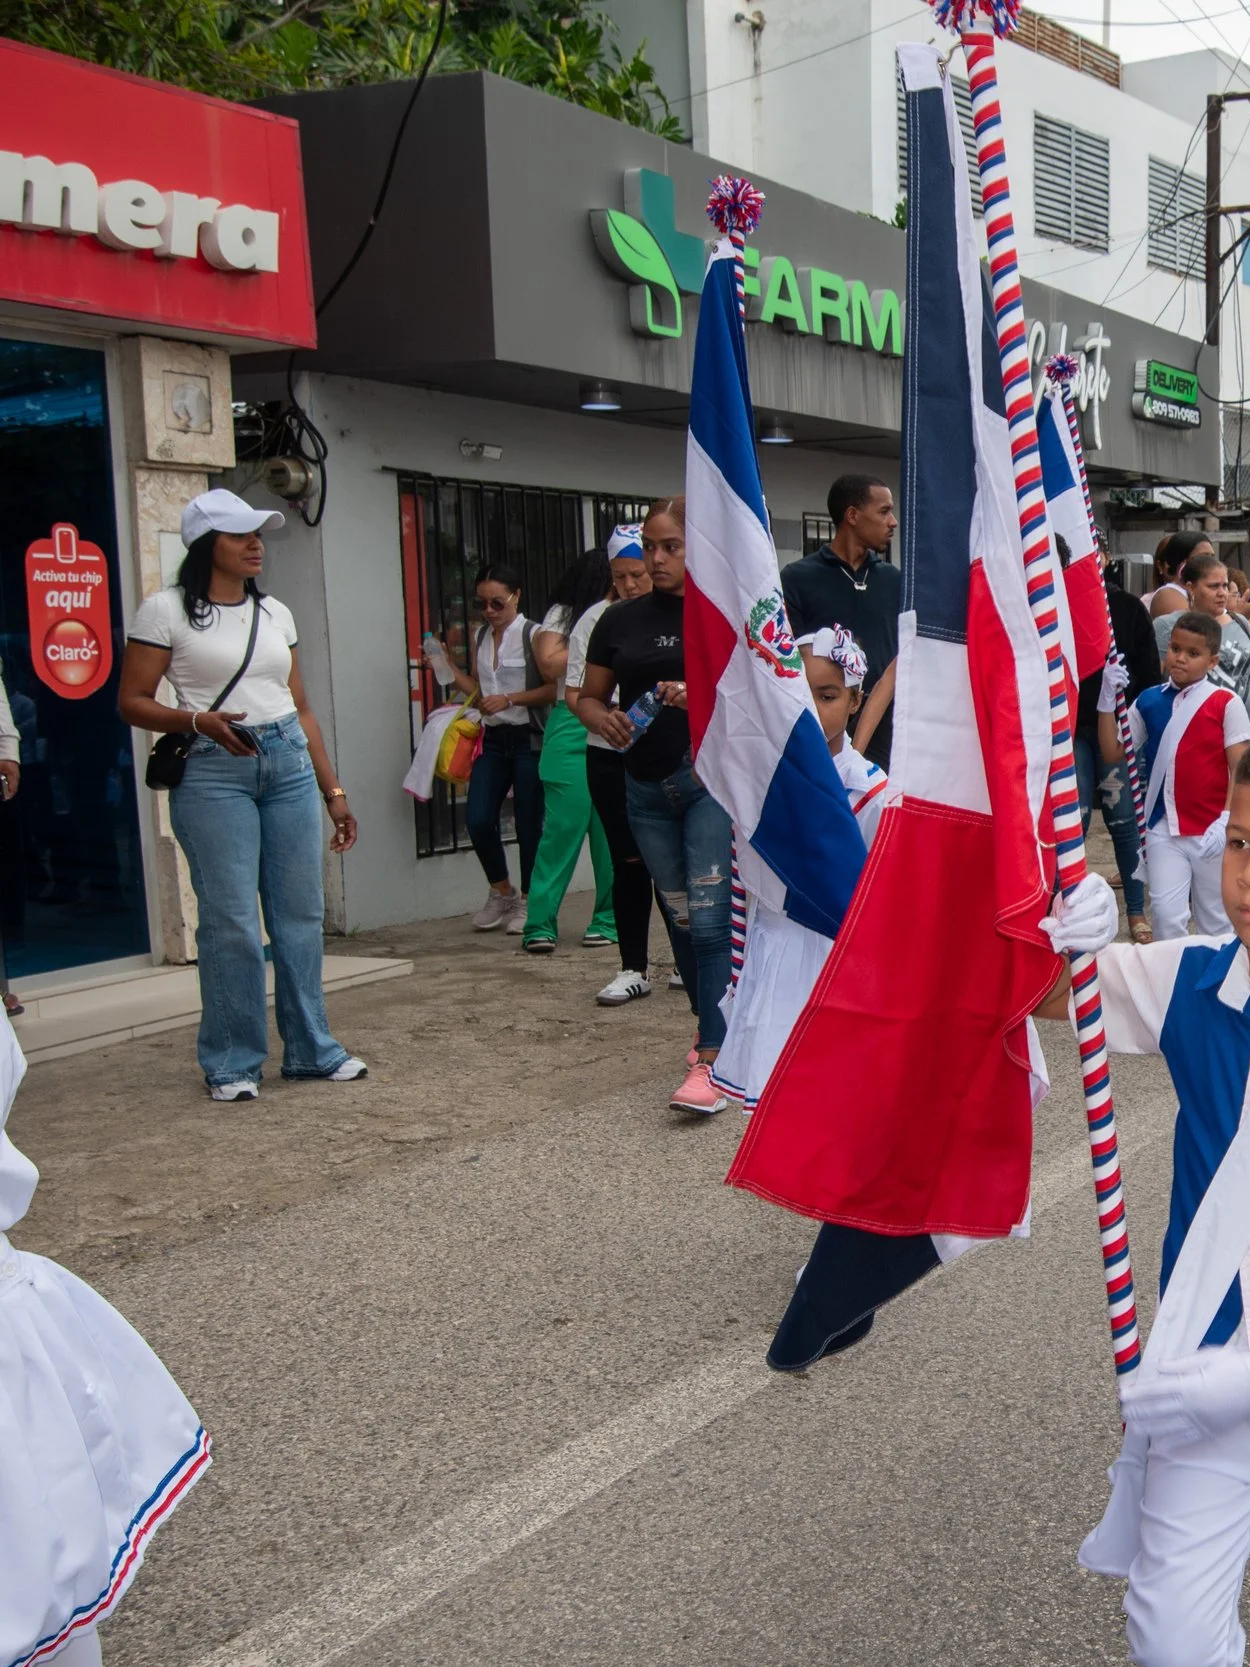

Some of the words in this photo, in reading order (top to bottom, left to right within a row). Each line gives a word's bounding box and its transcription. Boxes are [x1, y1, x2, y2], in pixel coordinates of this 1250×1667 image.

[0, 150, 279, 272] mera
[743, 246, 905, 357] FARM
[1152, 369, 1196, 397] DELIVERY
[1152, 399, 1168, 417] 809
[33, 569, 66, 583] Activa
[67, 571, 79, 583] tu
[80, 571, 103, 586] chip
[45, 586, 93, 613] aquí
[46, 641, 96, 662] Claro
